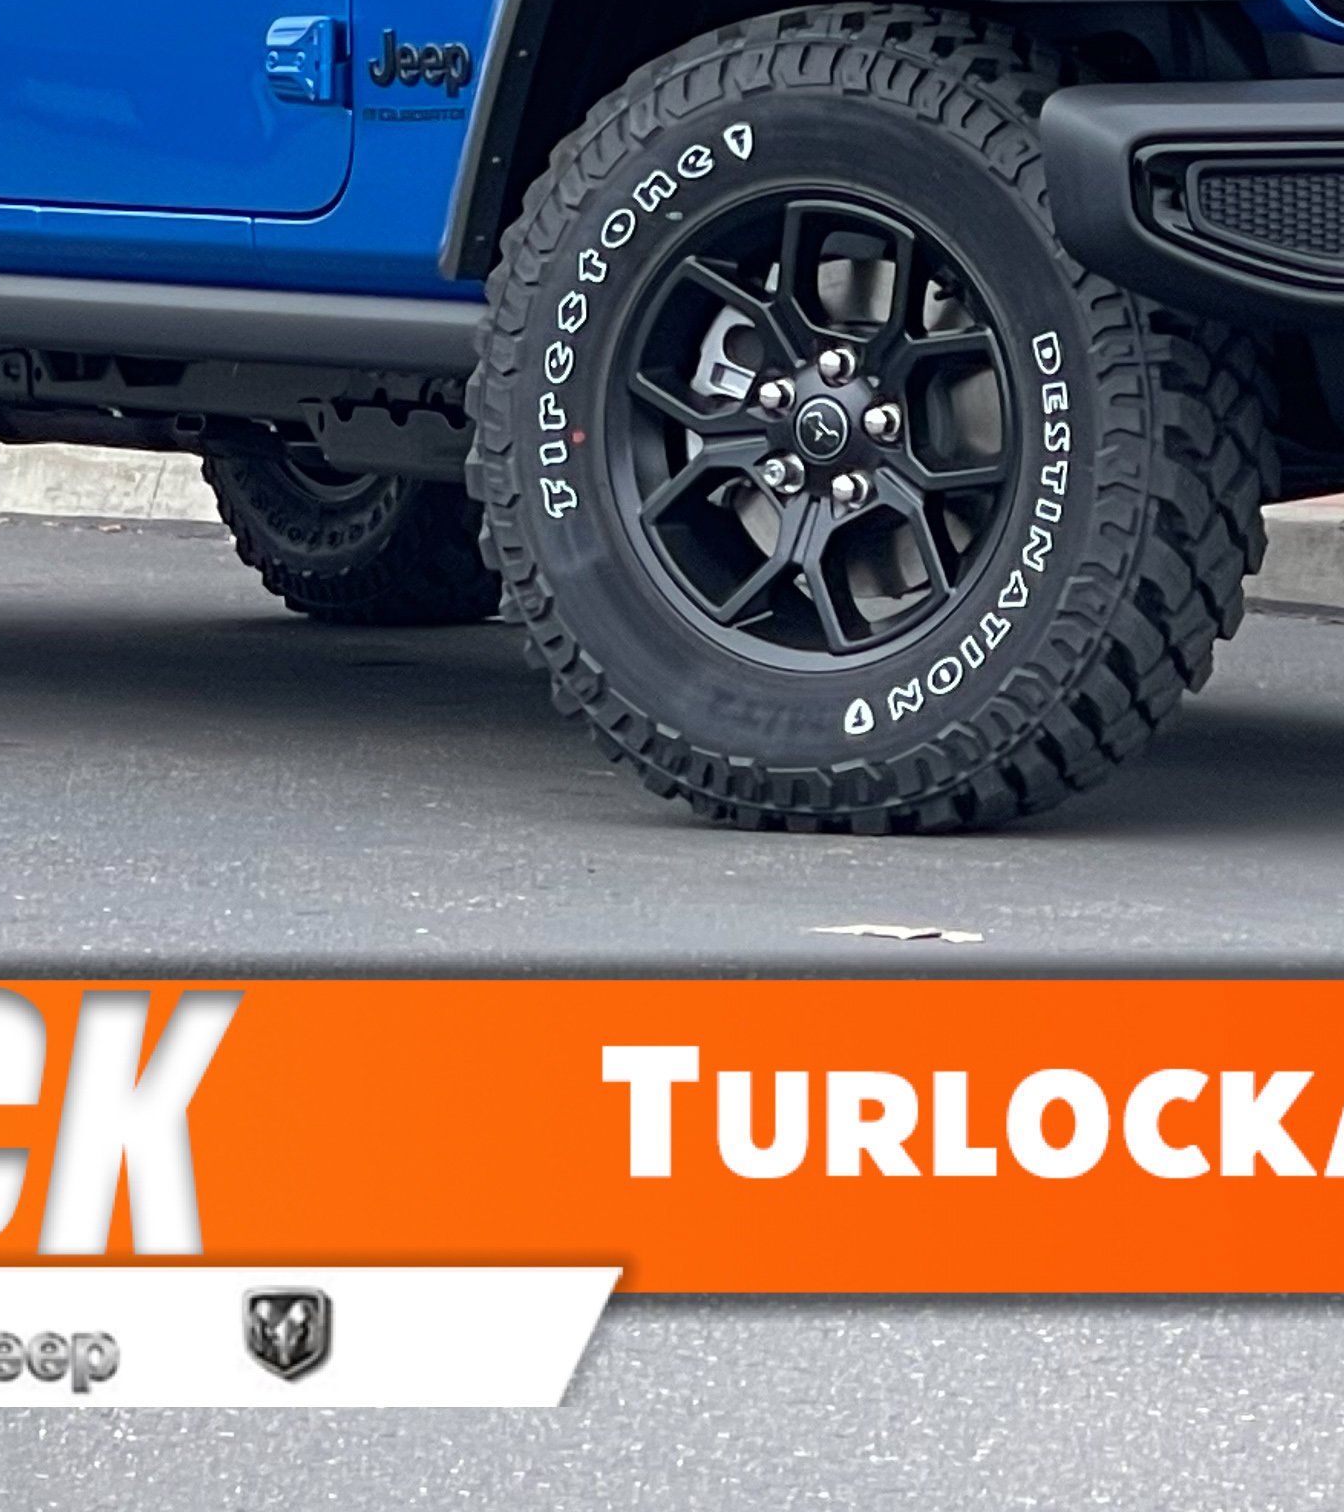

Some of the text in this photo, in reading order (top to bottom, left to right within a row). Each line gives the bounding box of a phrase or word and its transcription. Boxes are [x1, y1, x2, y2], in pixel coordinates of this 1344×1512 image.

[368, 28, 473, 99] Jeep
[539, 143, 714, 519] Firestone
[887, 331, 1071, 722] DESTINATION
